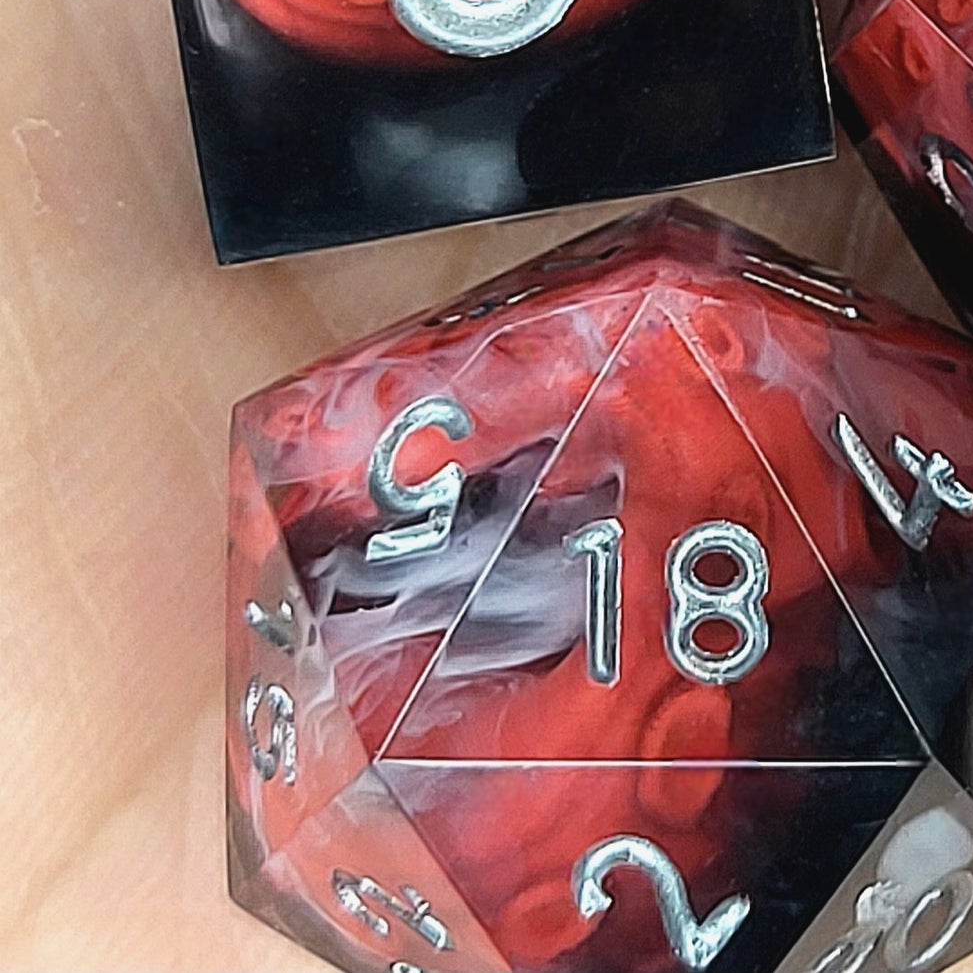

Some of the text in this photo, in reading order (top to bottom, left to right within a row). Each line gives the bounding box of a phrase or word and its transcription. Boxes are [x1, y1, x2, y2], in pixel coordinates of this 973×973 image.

[365, 395, 474, 561] 5
[563, 519, 770, 686] 18
[570, 833, 752, 973] 2
